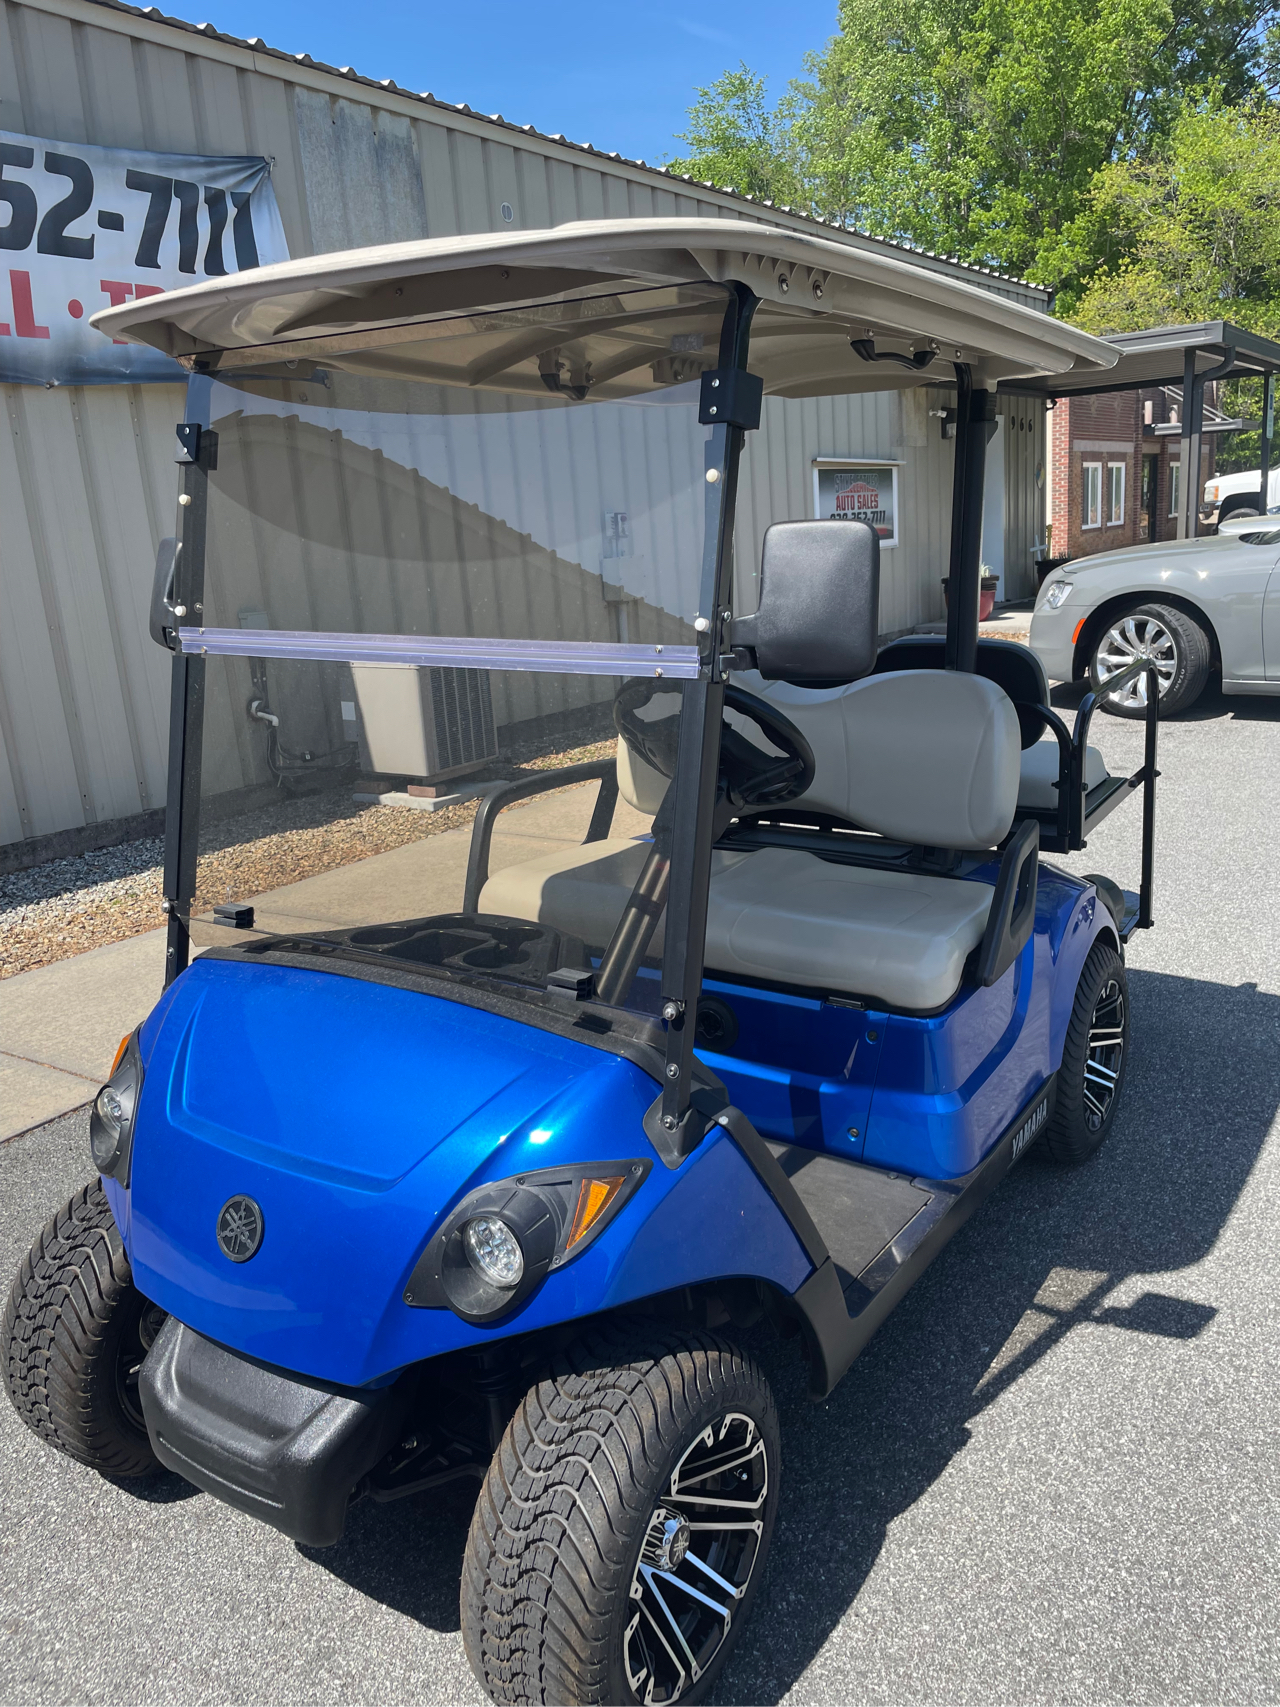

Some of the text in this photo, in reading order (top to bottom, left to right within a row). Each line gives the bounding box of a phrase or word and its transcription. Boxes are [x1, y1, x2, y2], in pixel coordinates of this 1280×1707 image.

[1011, 415, 1033, 433] 966
[836, 493, 879, 511] AUTO SALES
[1012, 1098, 1047, 1159] YAMAHA
